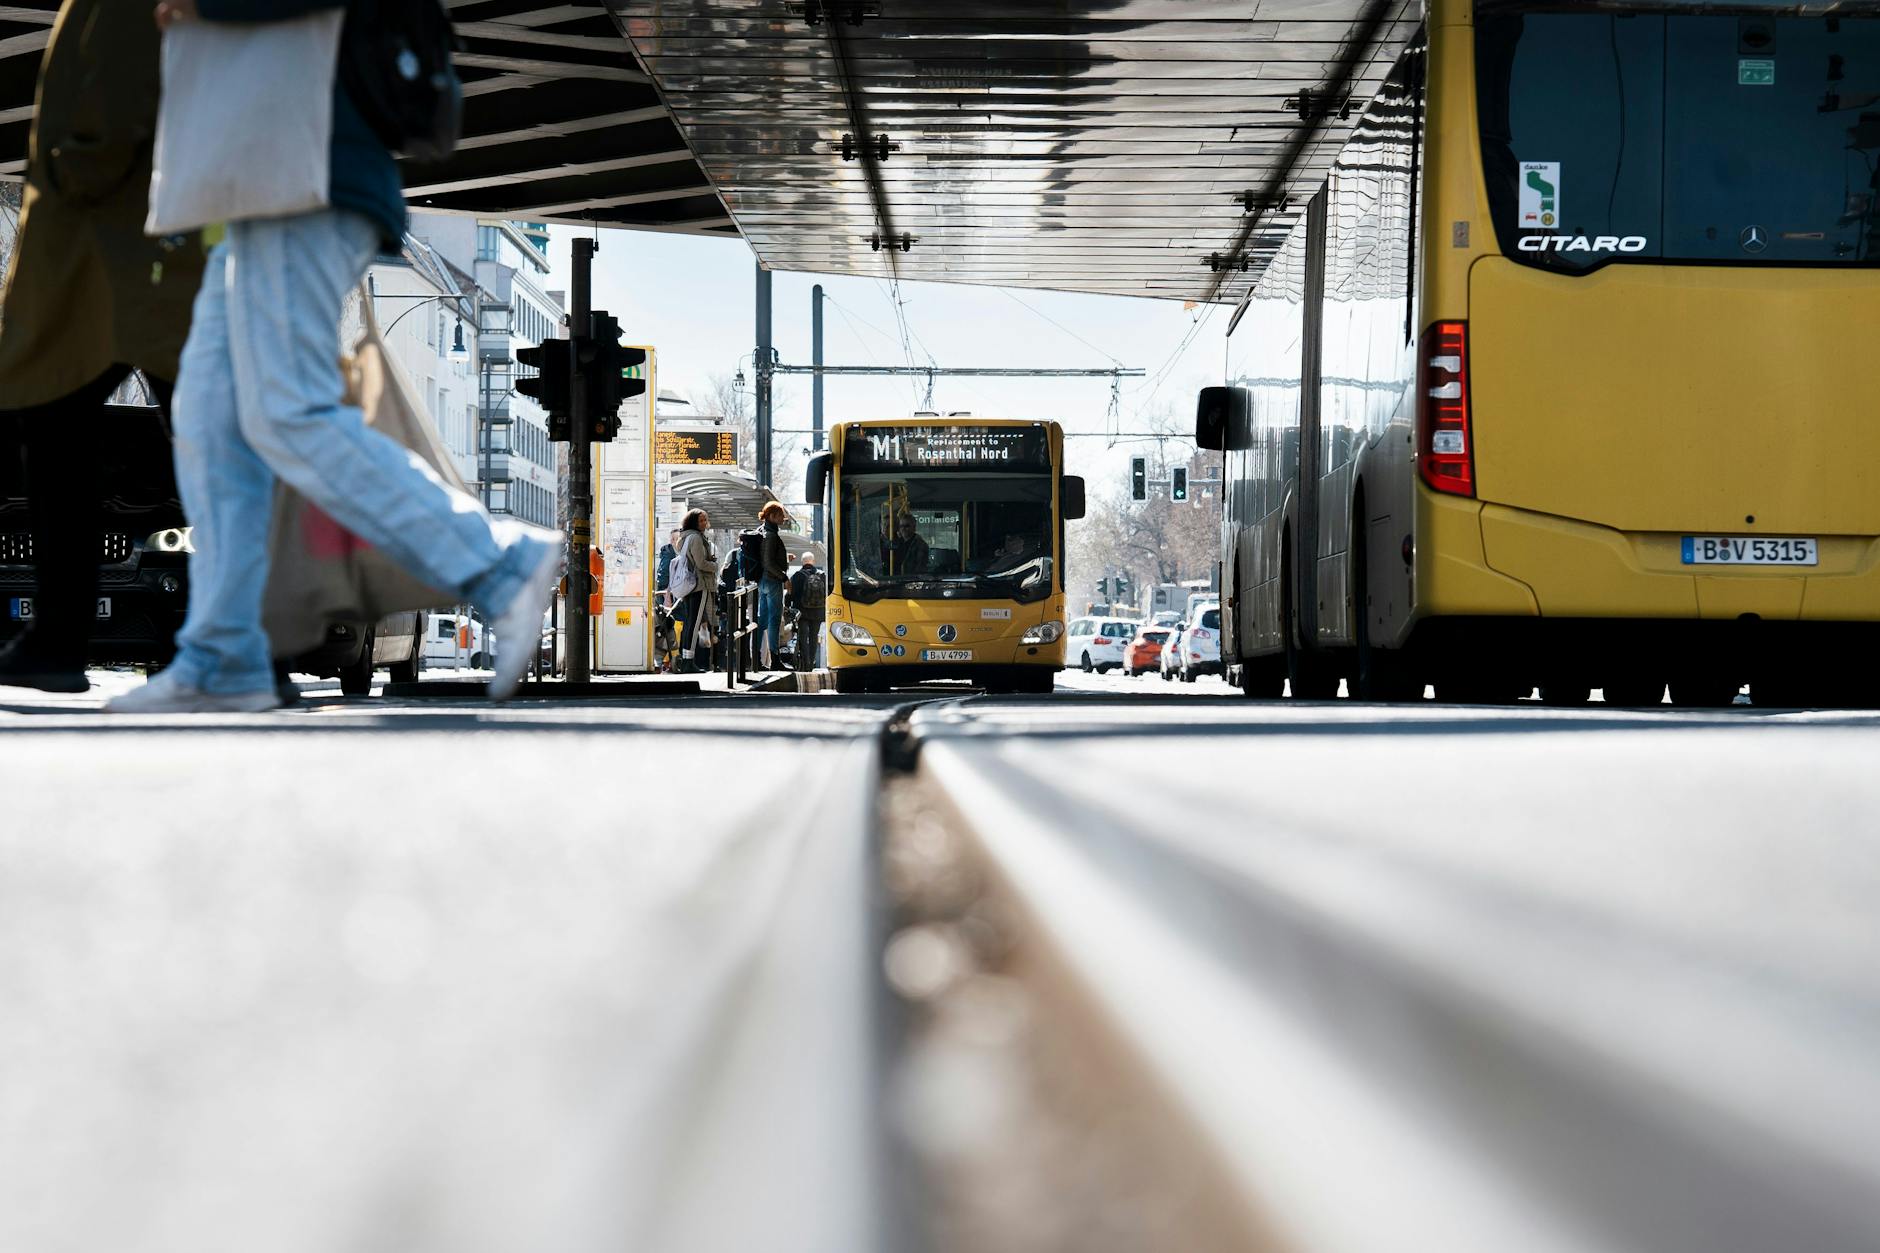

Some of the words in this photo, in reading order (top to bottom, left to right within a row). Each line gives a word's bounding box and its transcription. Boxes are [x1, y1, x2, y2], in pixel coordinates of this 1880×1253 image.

[1517, 235, 1647, 252] CITARO
[873, 434, 900, 460] M1
[917, 447, 976, 459] Rosenthal
[981, 447, 1008, 459] Nord
[1704, 540, 1717, 560] B
[1733, 540, 1746, 560] V
[1752, 540, 1807, 561] 5315
[20, 600, 32, 616] B
[617, 617, 630, 625] BVG
[930, 651, 936, 659] B
[941, 651, 947, 659] V
[948, 651, 969, 659] 4799
